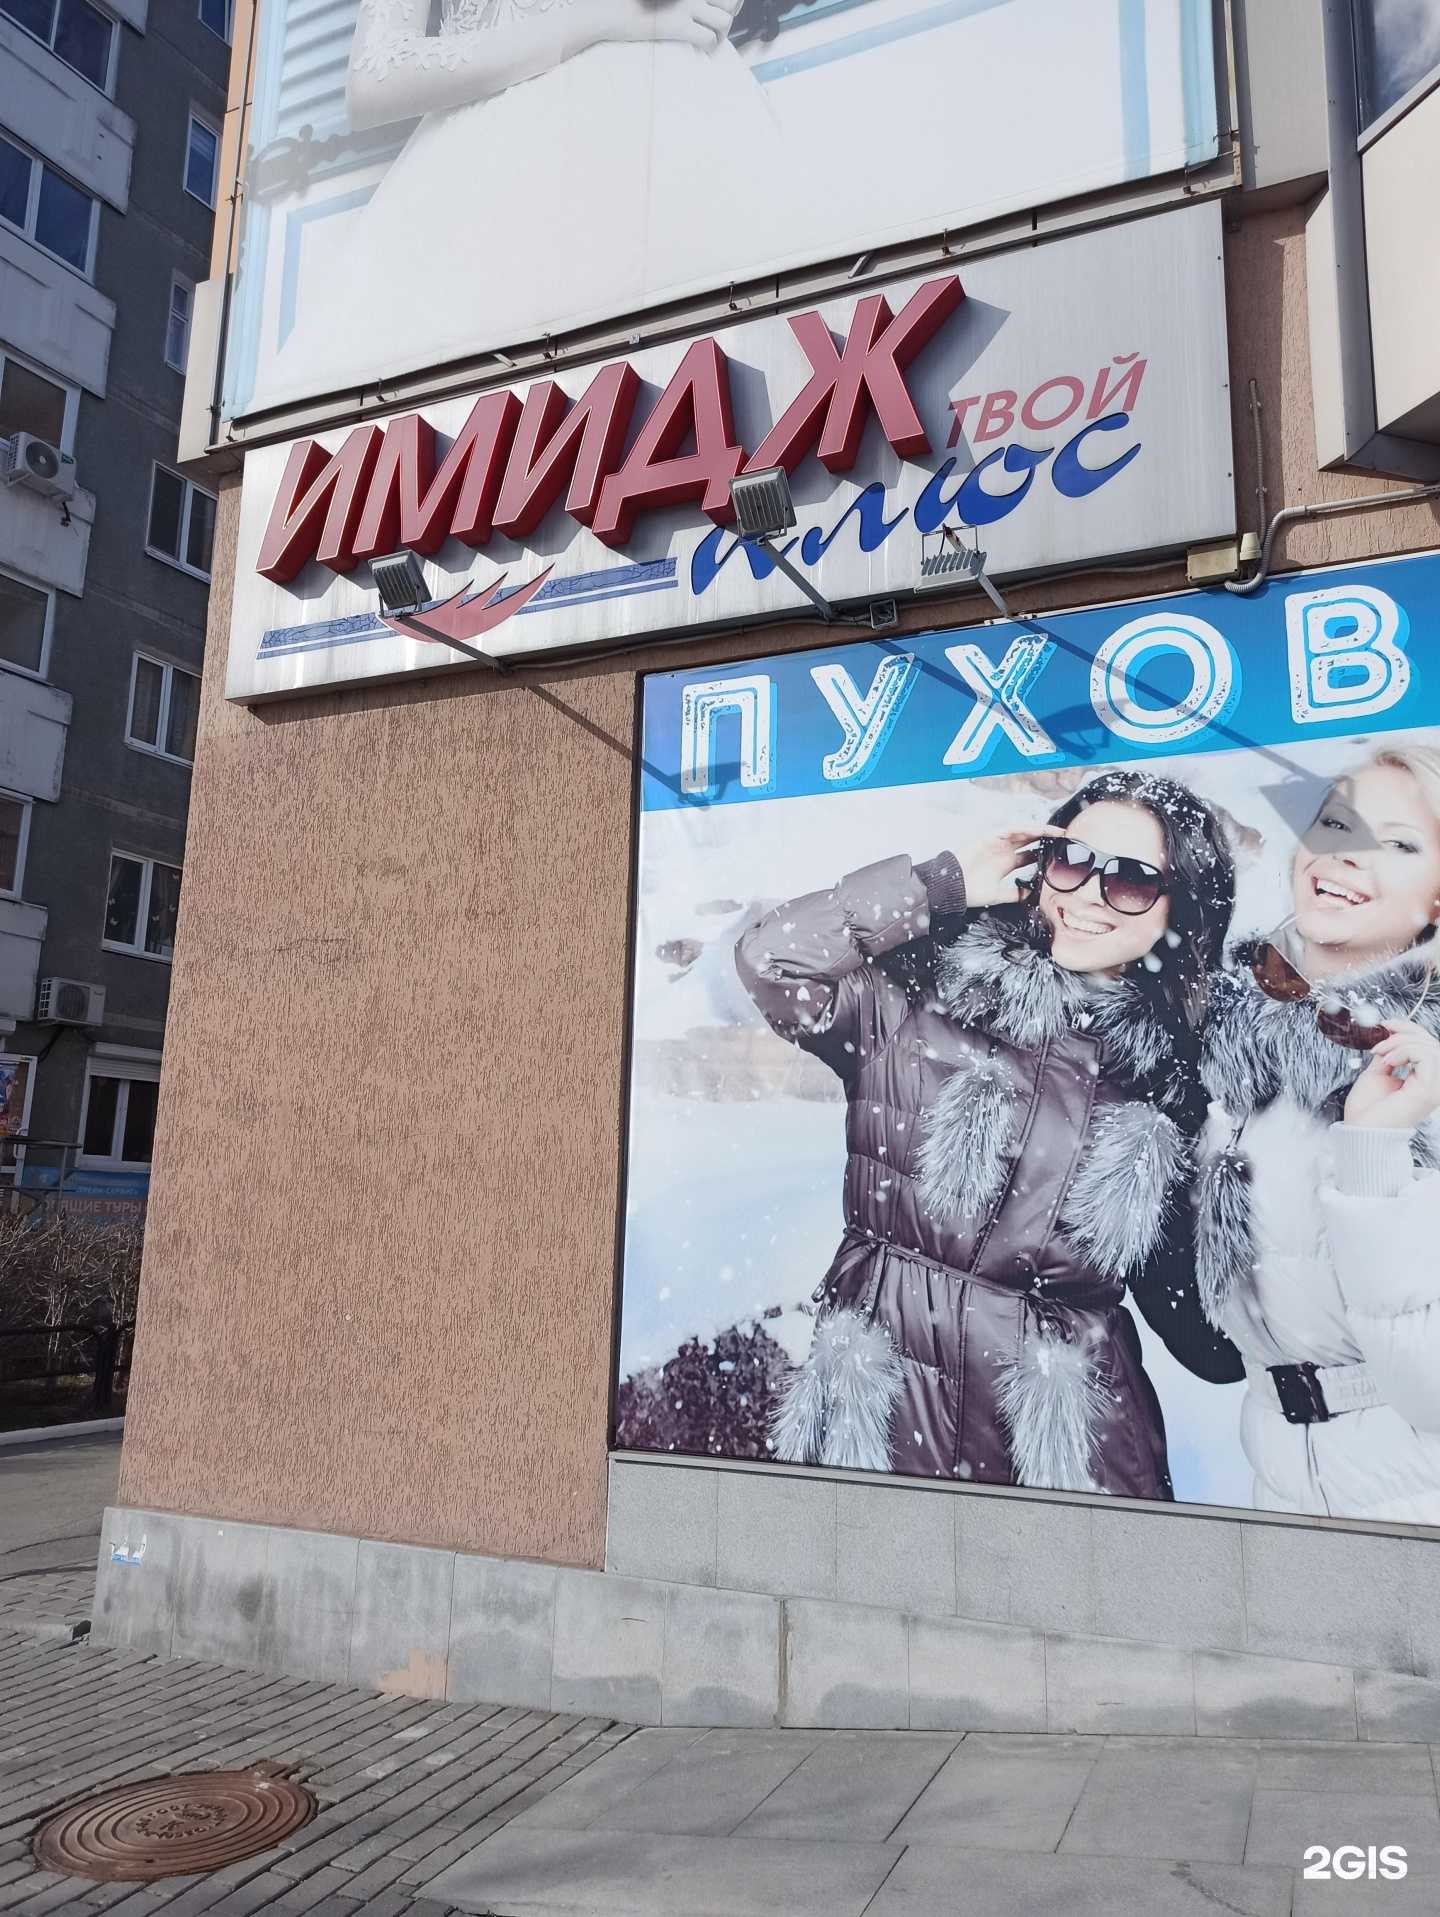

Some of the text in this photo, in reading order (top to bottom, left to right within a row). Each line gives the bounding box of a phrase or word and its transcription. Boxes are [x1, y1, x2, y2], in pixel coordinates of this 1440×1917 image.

[256, 275, 966, 584] ИМИДЖ
[946, 352, 1147, 448] ТВОЙ
[681, 585, 1410, 793] ПУХОВ
[105, 1200, 142, 1213] ТУРЫ
